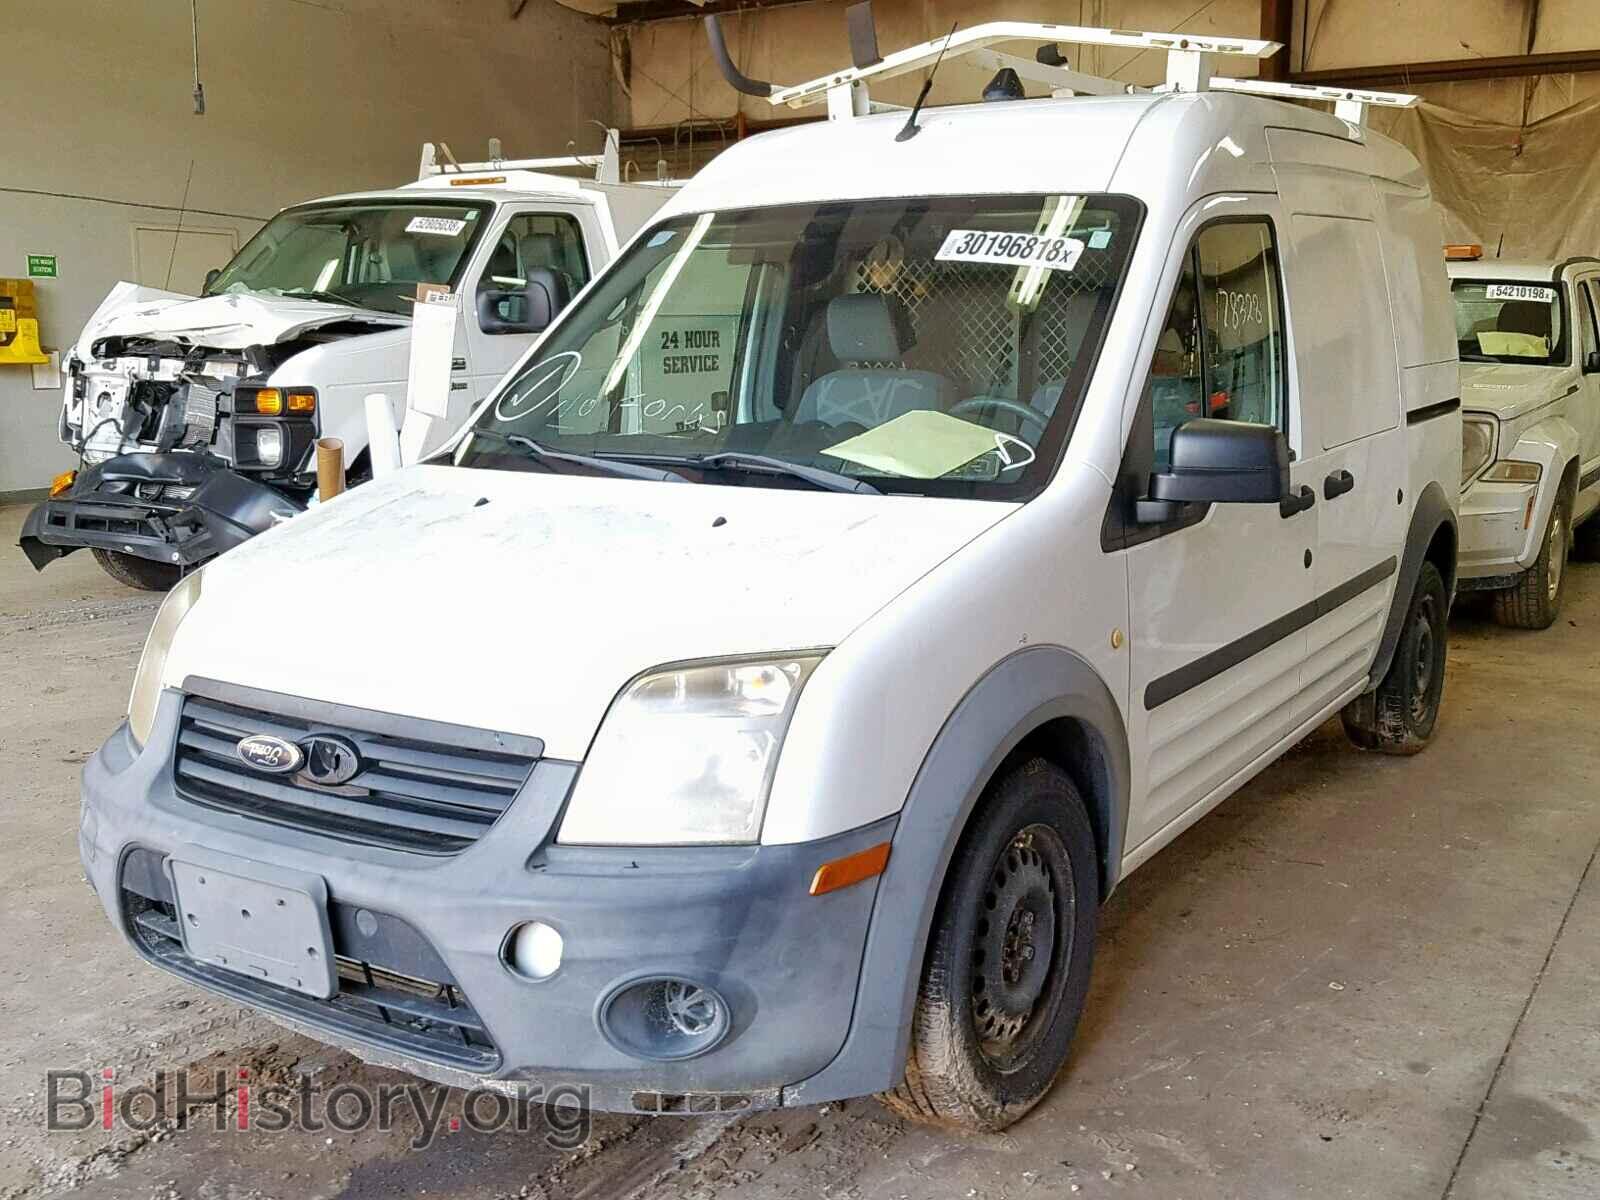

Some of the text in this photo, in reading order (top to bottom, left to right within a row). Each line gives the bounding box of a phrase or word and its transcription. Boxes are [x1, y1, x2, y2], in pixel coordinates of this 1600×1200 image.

[661, 330, 720, 349] 24 HOUR
[663, 354, 719, 374] SERVICE
